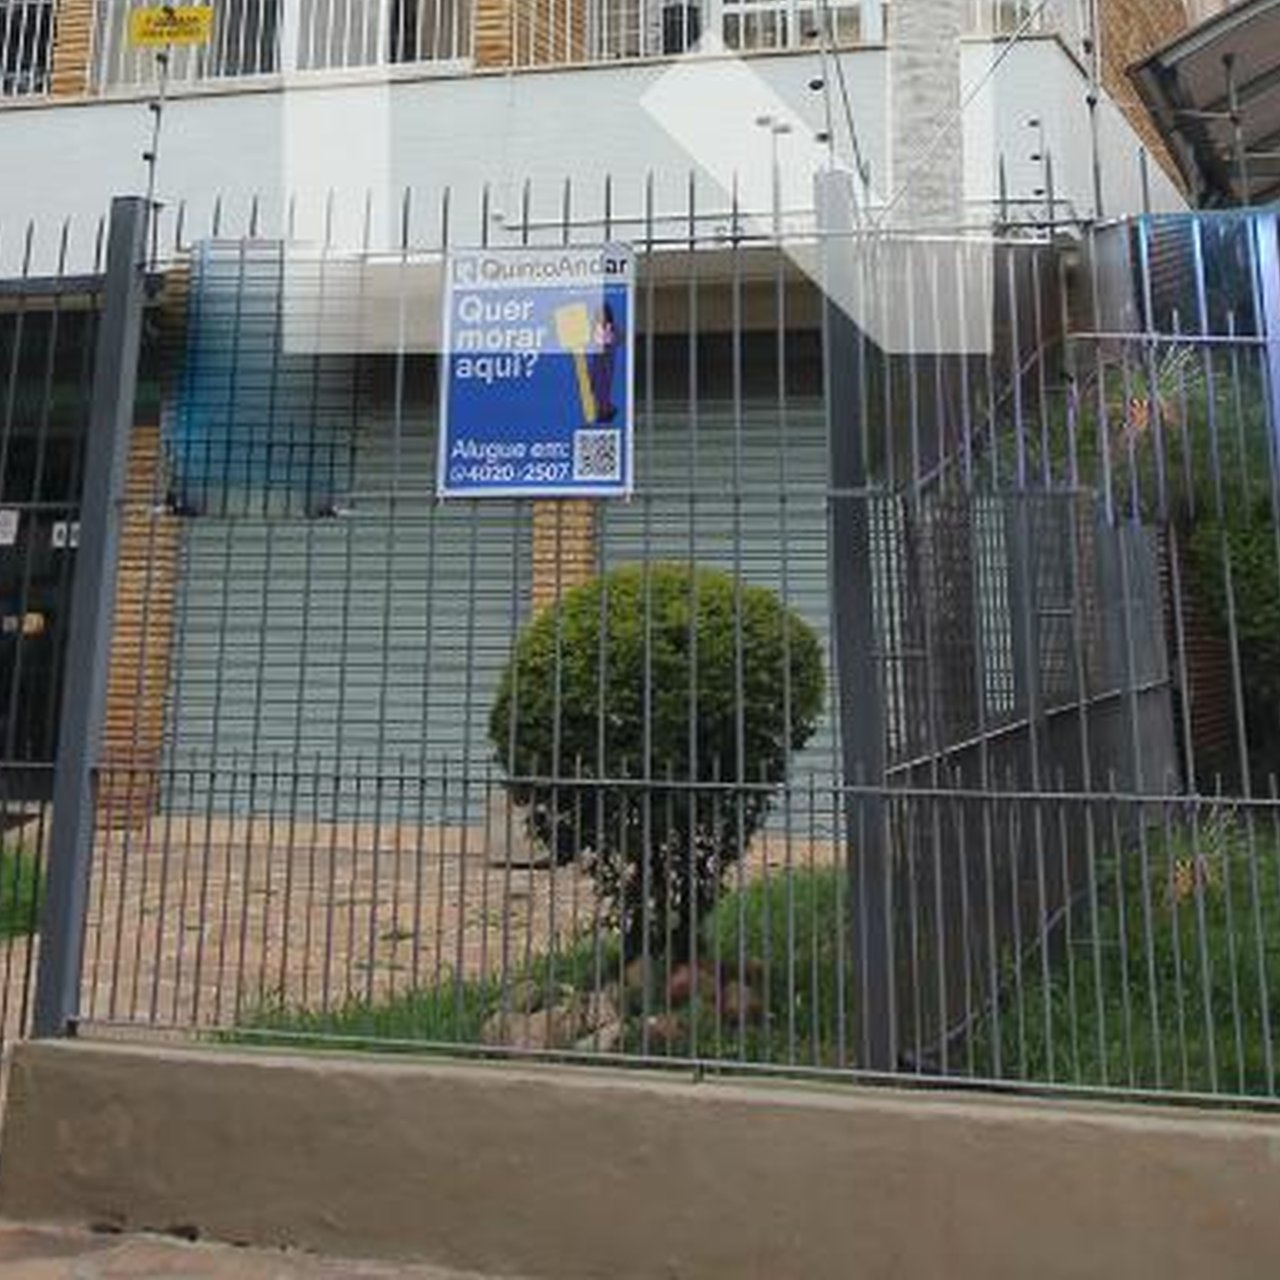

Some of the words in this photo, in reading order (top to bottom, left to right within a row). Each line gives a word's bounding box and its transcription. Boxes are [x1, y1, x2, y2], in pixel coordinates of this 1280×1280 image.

[481, 256, 627, 279] QuintoAndar
[458, 294, 534, 324] Quer
[458, 324, 543, 349] morar
[455, 351, 539, 384] aqui?
[451, 439, 526, 464] Alugue
